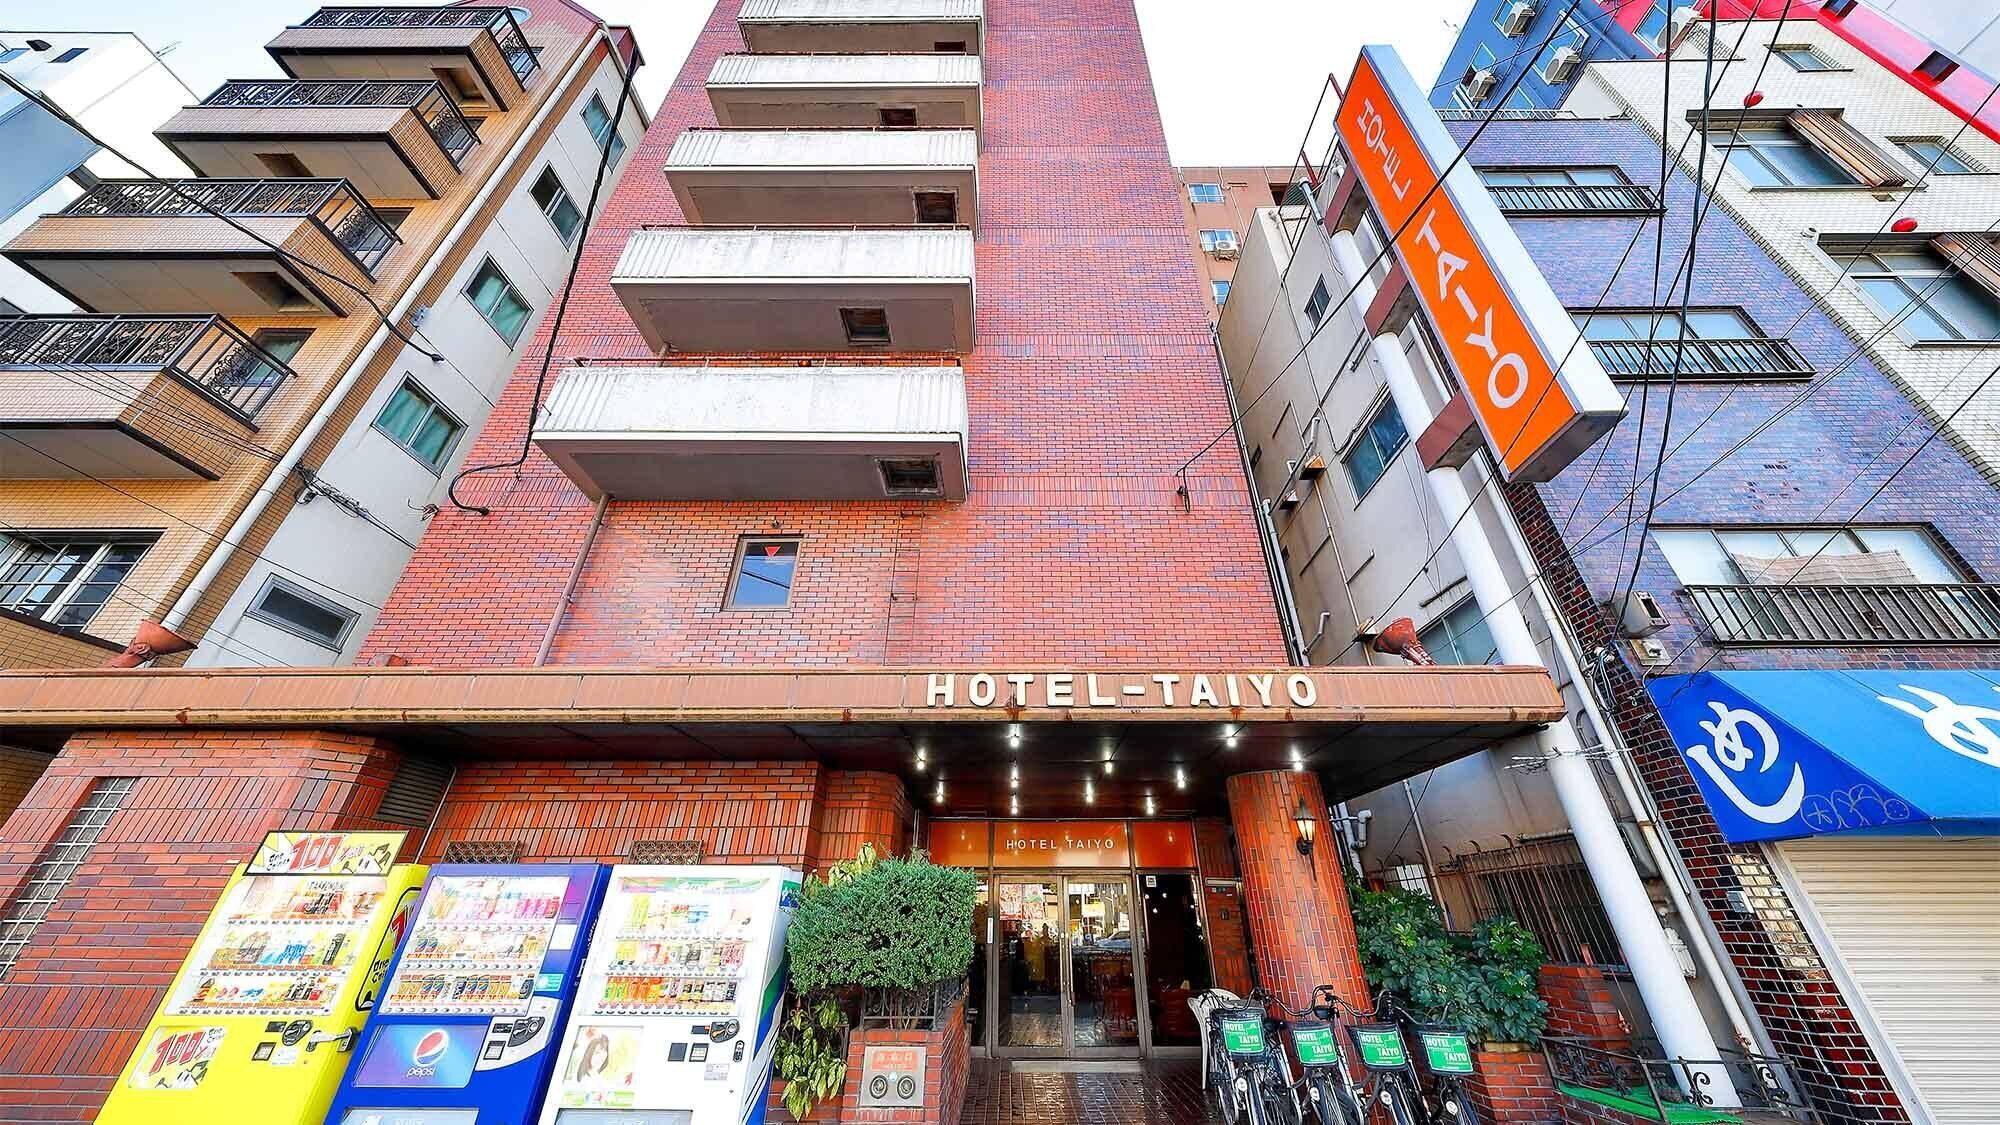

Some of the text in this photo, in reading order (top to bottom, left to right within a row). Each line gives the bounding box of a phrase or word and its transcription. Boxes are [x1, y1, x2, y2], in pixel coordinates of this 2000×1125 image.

[1357, 98, 1529, 409] HOTEL TAIYO
[1006, 839, 1115, 849] HOTEL TAIYO
[288, 835, 345, 871] 100
[1225, 1022, 1245, 1032] HOTEL
[1238, 1035, 1259, 1044] TAIYO
[1296, 1032, 1317, 1041] HOTEL
[1360, 1034, 1384, 1044] HOTEL
[1425, 1037, 1450, 1048] HOTEL
[149, 1031, 206, 1077] 100
[1312, 1044, 1333, 1054] TAIYO
[1376, 1047, 1400, 1057] TAIYO
[1445, 1052, 1468, 1063] TAIYO
[406, 1066, 437, 1077] pepsi
